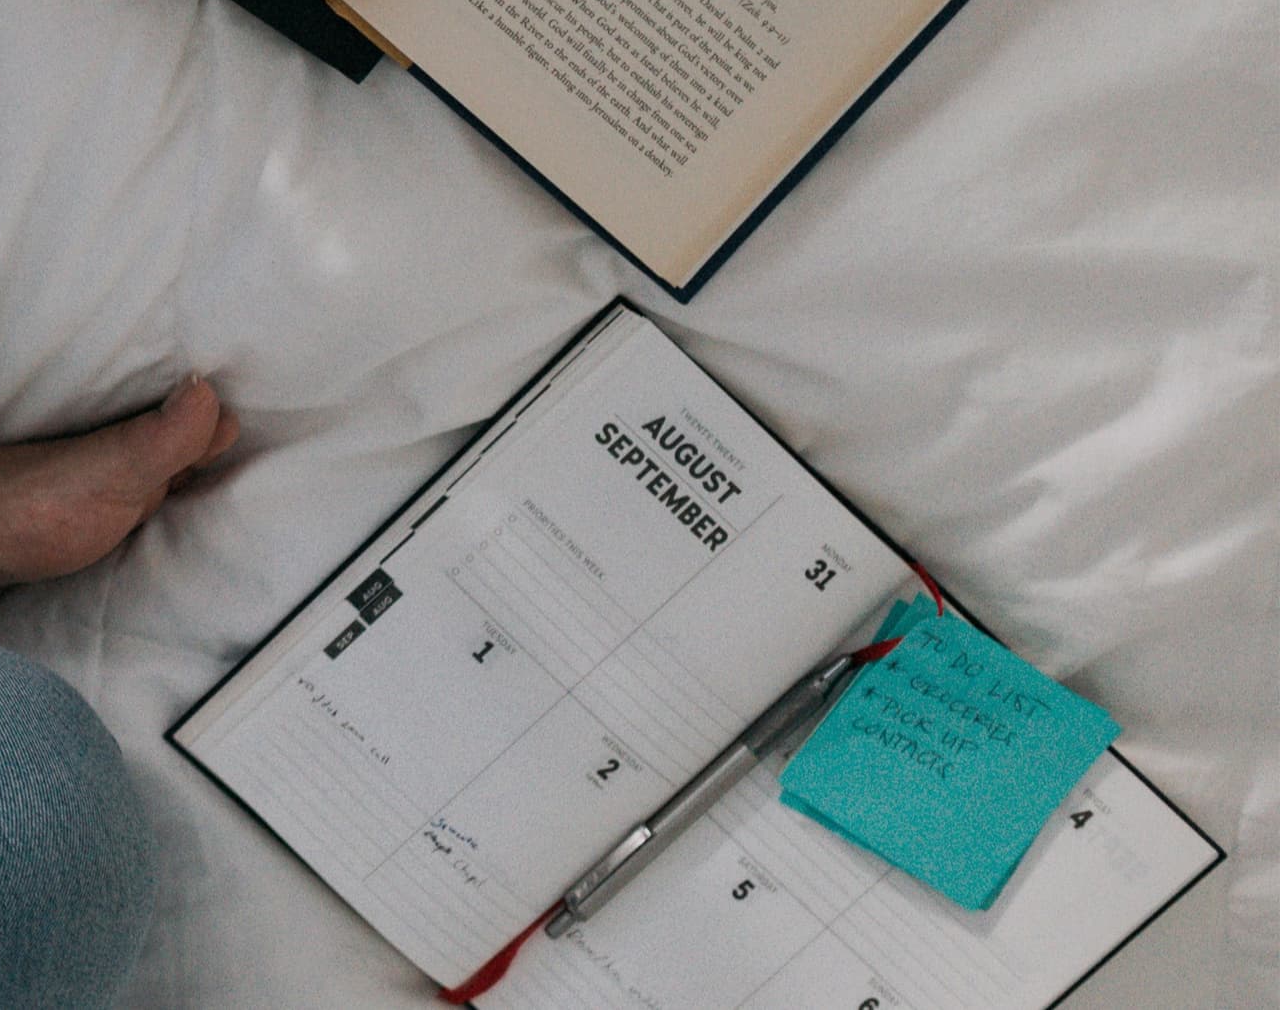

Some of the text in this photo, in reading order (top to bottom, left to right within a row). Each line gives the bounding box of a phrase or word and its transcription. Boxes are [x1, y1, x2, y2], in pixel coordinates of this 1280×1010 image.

[641, 416, 741, 503] AUGUST
[595, 423, 728, 551] SEPTEMBER
[804, 559, 836, 591] 31
[362, 581, 382, 601] AUG
[373, 595, 393, 616] AUG
[482, 620, 522, 654] TUESDAY
[472, 641, 494, 663] 1
[987, 679, 1053, 719] LIST
[596, 758, 620, 780] 2
[1069, 810, 1093, 829] 4
[732, 879, 755, 900] 5
